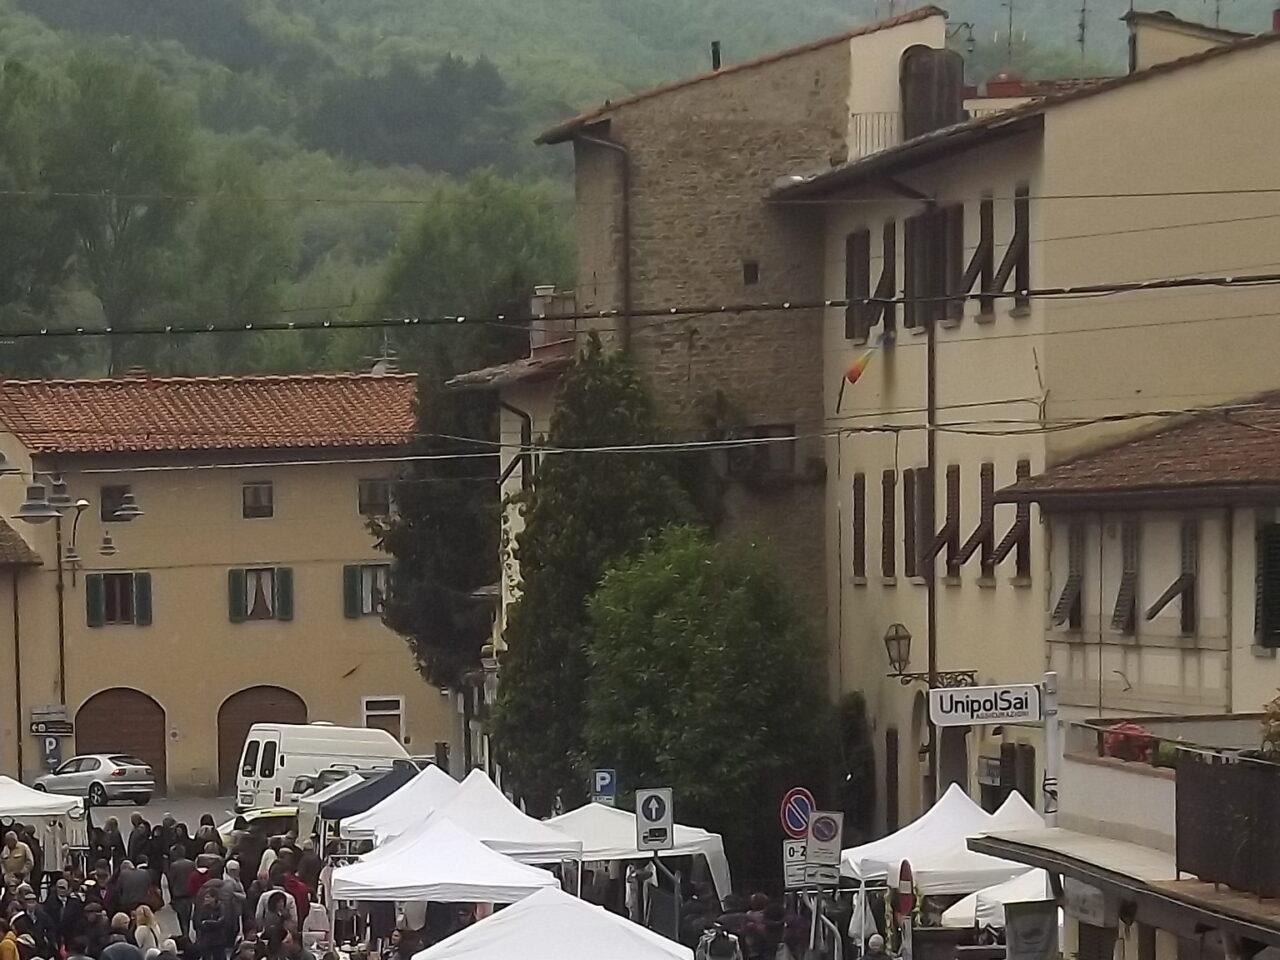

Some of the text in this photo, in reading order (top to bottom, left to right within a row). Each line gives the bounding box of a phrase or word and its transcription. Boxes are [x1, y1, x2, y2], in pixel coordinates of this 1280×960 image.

[939, 690, 1029, 720] UnipolSai
[45, 737, 57, 754] P
[595, 772, 611, 792] P
[788, 845, 806, 858] 0-2
